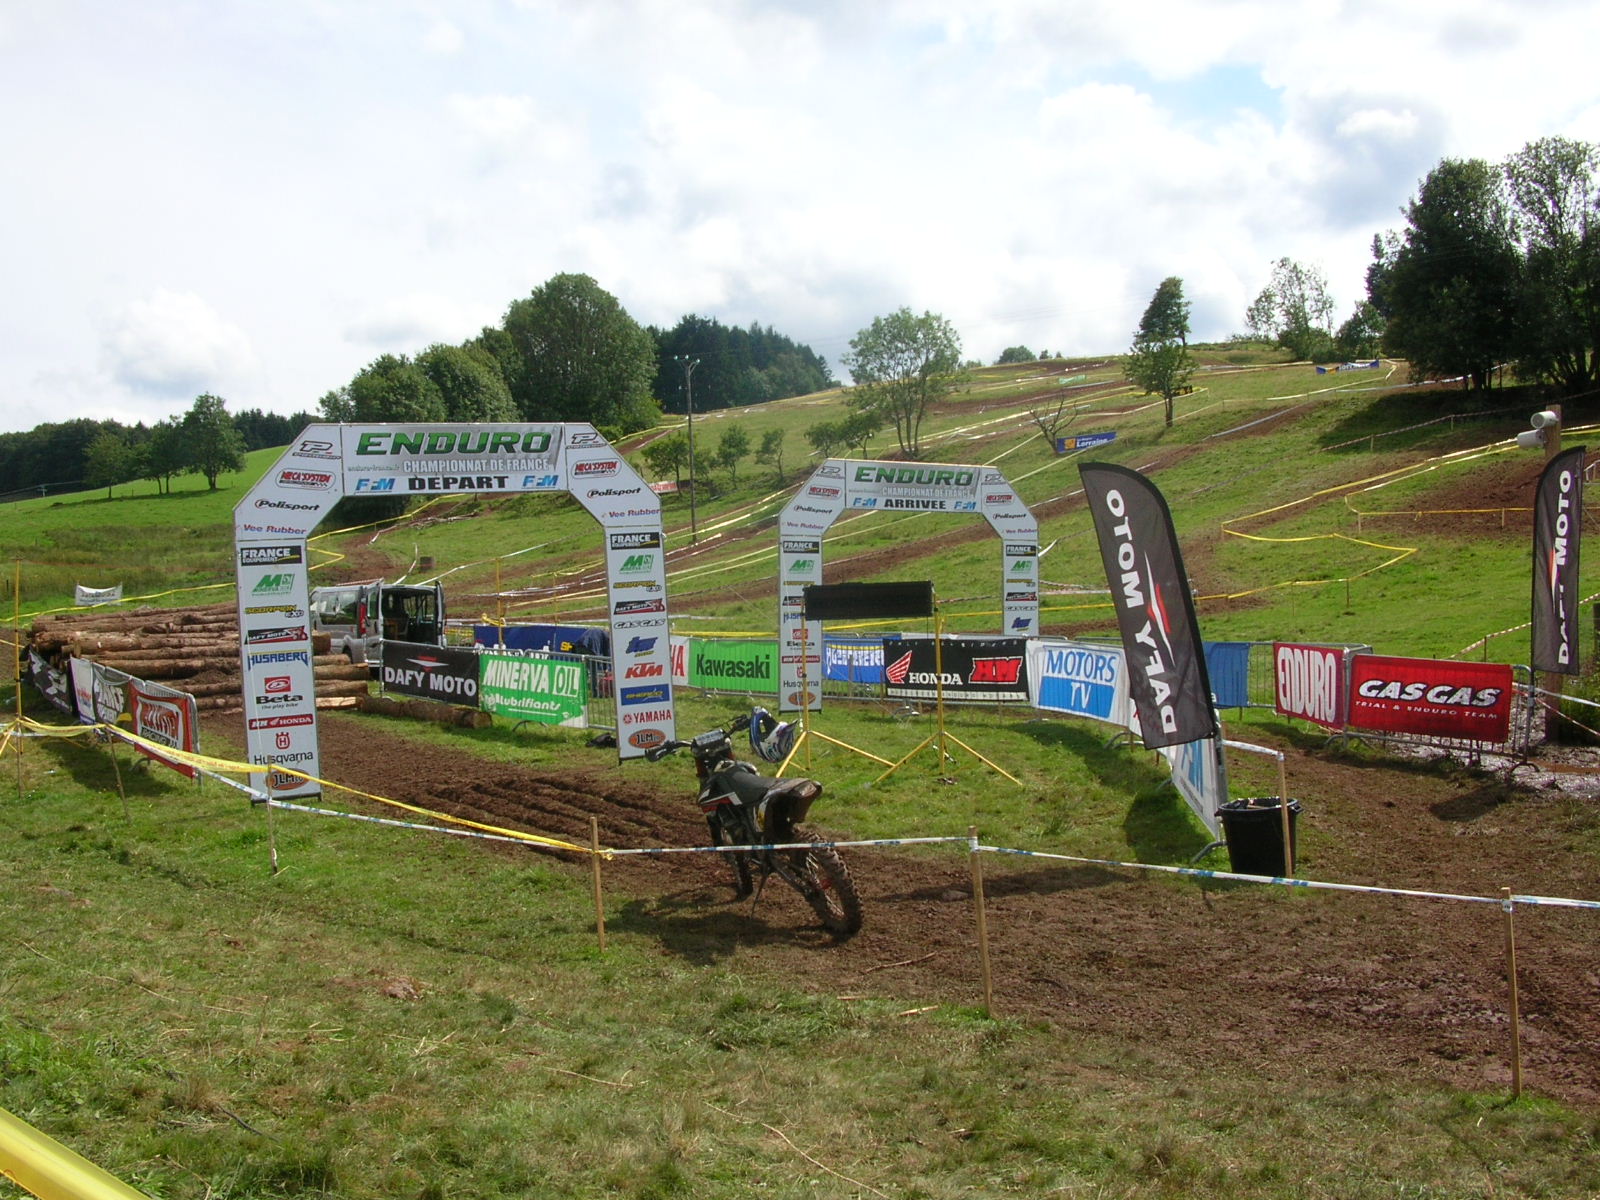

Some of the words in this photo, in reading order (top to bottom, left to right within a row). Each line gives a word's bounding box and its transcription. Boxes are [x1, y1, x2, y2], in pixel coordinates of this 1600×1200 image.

[356, 431, 551, 456] ENDURO
[403, 459, 487, 473] CHAMPIONNAT
[490, 459, 506, 472] DE
[507, 458, 549, 472] FRANCE
[408, 476, 509, 491] DEPART
[854, 466, 974, 486] ENDURO
[591, 488, 641, 497] Polisport
[882, 486, 934, 497] CHAMPIONNAT
[260, 501, 319, 511] Polisport
[884, 499, 947, 509] ARRIVEE
[628, 508, 660, 517] Rubber
[1555, 470, 1571, 566] MOTO
[244, 524, 263, 533] Vee
[266, 525, 307, 535] Rubber
[612, 534, 651, 544] FRANCE
[243, 548, 291, 559] FRANCE
[248, 651, 309, 670] HUSABERG
[696, 653, 770, 679] Kawasaki
[1046, 650, 1118, 682] MOTORS
[483, 659, 549, 694] MINERVA
[554, 665, 580, 697] OIL
[625, 662, 663, 679] KTM
[384, 666, 425, 688] DAFY
[429, 672, 477, 697] MOTO
[909, 672, 963, 686] HONDA
[1277, 646, 1336, 723] ENDURO
[256, 694, 303, 705] Beta
[499, 694, 561, 711] Lubrifiants
[1069, 681, 1093, 709] TV
[633, 709, 672, 723] YAMAHA
[1355, 701, 1387, 709] TRIAL
[1407, 705, 1458, 715] ENDURO
[1464, 711, 1498, 719] TEAM
[280, 717, 312, 725] HONDA
[253, 751, 314, 766] Husqvarna
